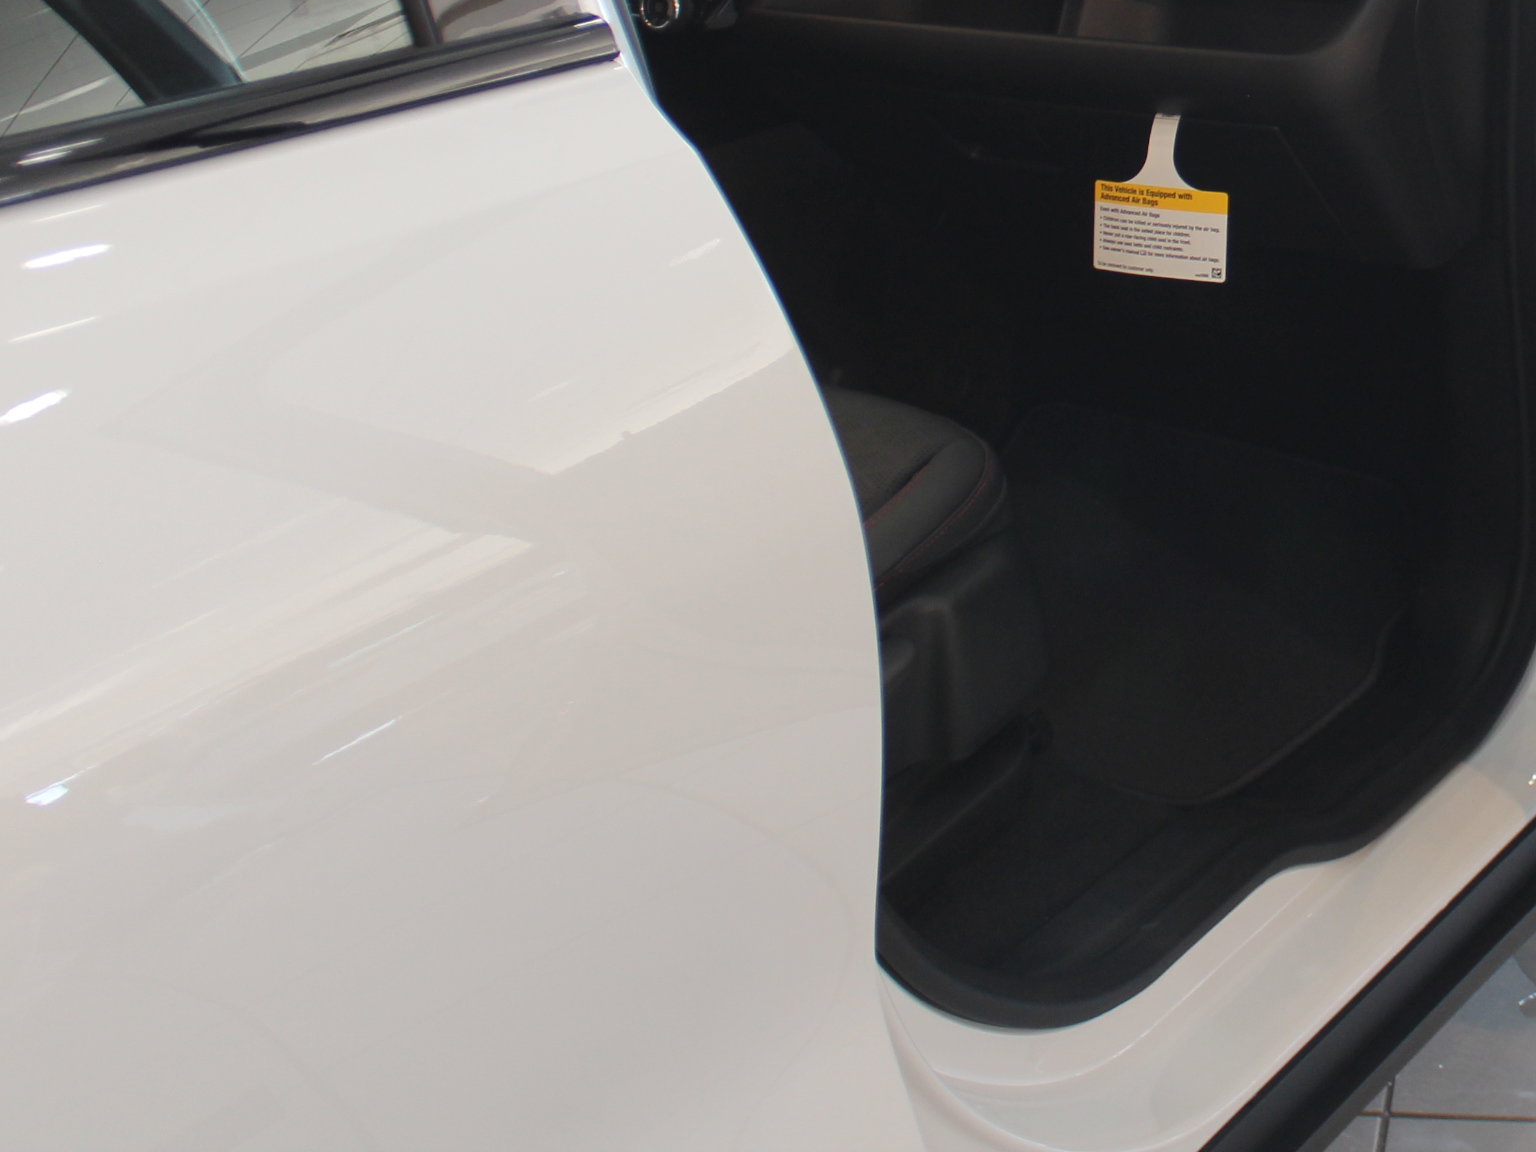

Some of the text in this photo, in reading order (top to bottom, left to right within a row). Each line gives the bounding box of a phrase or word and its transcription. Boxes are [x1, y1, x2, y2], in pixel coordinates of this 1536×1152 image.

[1101, 183, 1193, 201] This Vehicle is Equipped with
[1101, 192, 1159, 207] Advanced Air Bags
